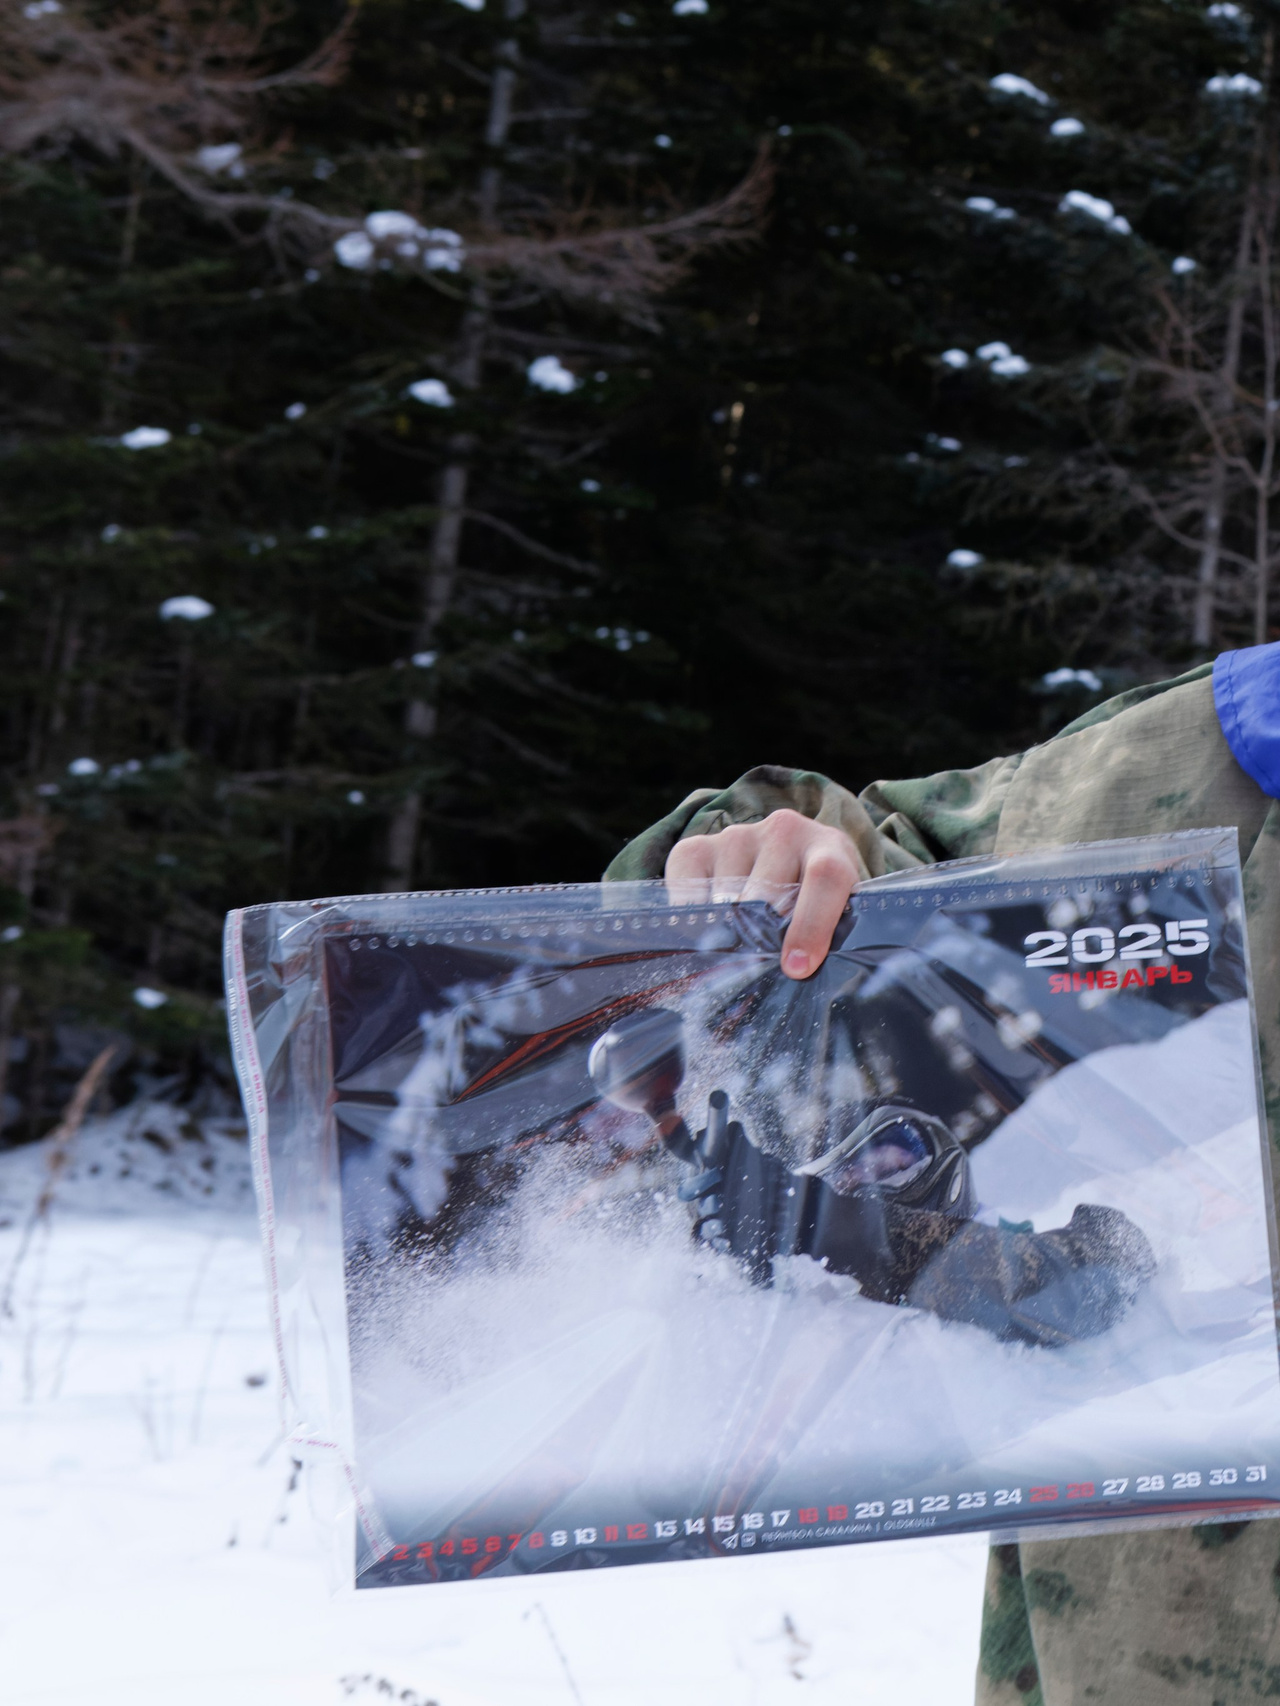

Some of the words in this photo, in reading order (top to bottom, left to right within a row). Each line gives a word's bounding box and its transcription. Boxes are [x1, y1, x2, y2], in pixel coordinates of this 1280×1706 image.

[1024, 918, 1210, 968] 2025
[1048, 964, 1193, 994] ЯНВАРЬ
[392, 1545, 409, 1561] 2
[416, 1542, 435, 1558] 3
[440, 1539, 454, 1556] 4
[461, 1537, 478, 1554] 5
[507, 1533, 522, 1551] 7
[529, 1532, 544, 1548] 8
[574, 1527, 597, 1544] 10
[604, 1525, 619, 1542] 11
[626, 1523, 648, 1540] 12
[654, 1520, 678, 1538] 13
[684, 1517, 706, 1535] 14
[711, 1515, 735, 1533] 15
[770, 1509, 791, 1527] 17
[798, 1507, 819, 1524] 18
[855, 1501, 885, 1519] 20
[891, 1498, 914, 1516] 21
[920, 1495, 950, 1513] 22
[957, 1491, 987, 1510] 23
[993, 1488, 1022, 1506] 24
[1029, 1484, 1059, 1502] 25
[1102, 1478, 1129, 1496] 27
[1136, 1475, 1165, 1493] 28
[1209, 1468, 1238, 1486] 30
[1245, 1465, 1267, 1482] 31
